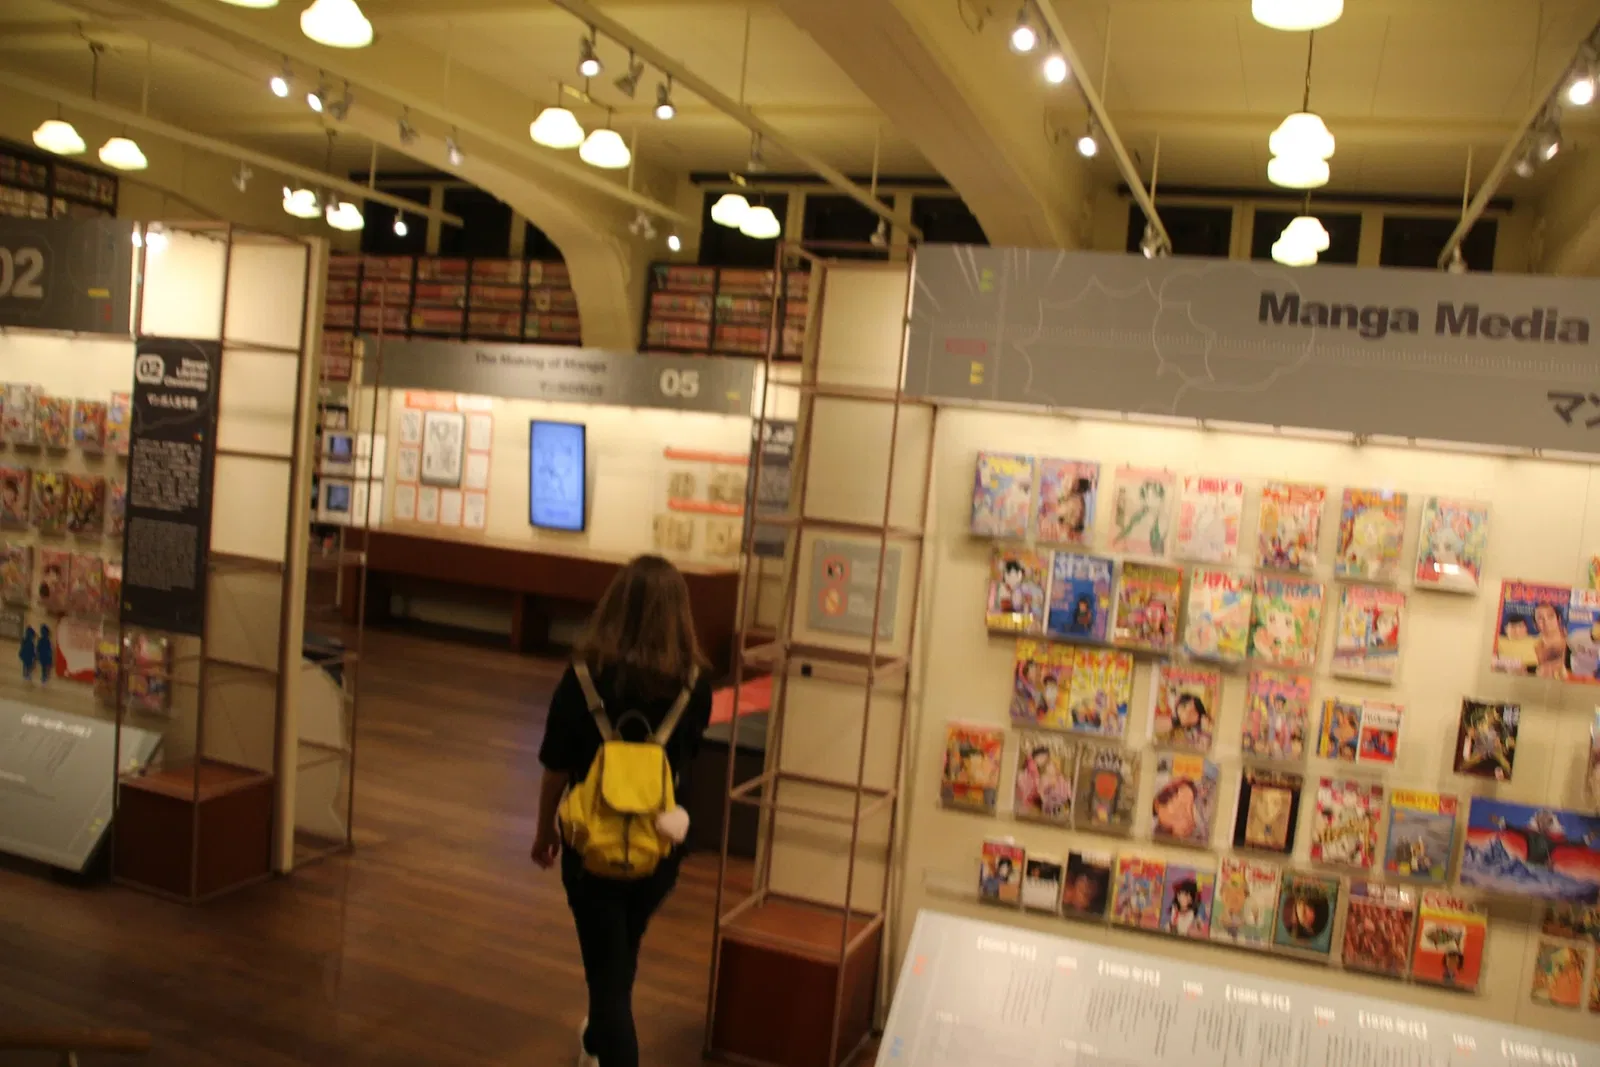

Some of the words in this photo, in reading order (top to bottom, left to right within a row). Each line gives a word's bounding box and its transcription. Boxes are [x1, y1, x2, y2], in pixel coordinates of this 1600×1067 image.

[1258, 289, 1419, 340] Manga
[1434, 301, 1590, 345] Media
[660, 368, 700, 398] 05
